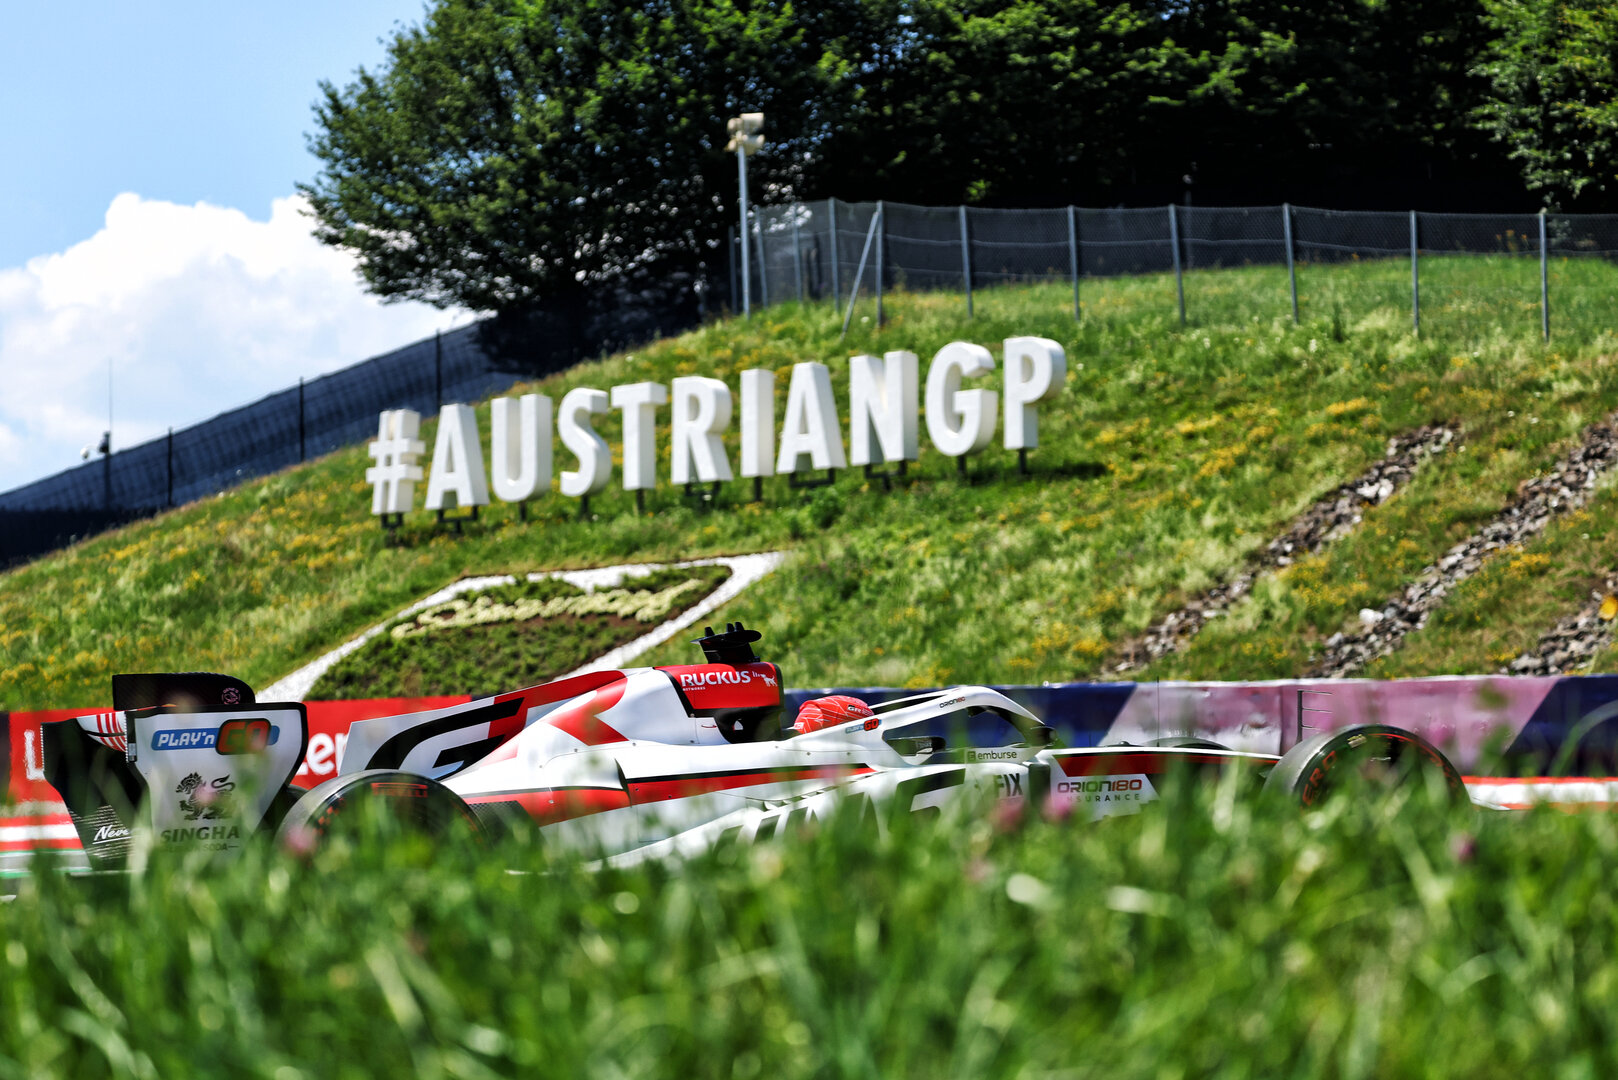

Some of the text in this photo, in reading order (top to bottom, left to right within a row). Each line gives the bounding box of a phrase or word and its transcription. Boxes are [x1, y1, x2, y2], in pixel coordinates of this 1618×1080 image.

[680, 671, 751, 687] RUCKUS
[977, 750, 1018, 760] emburse
[1065, 793, 1141, 803] NSURANCE
[160, 825, 240, 843] SINGHA
